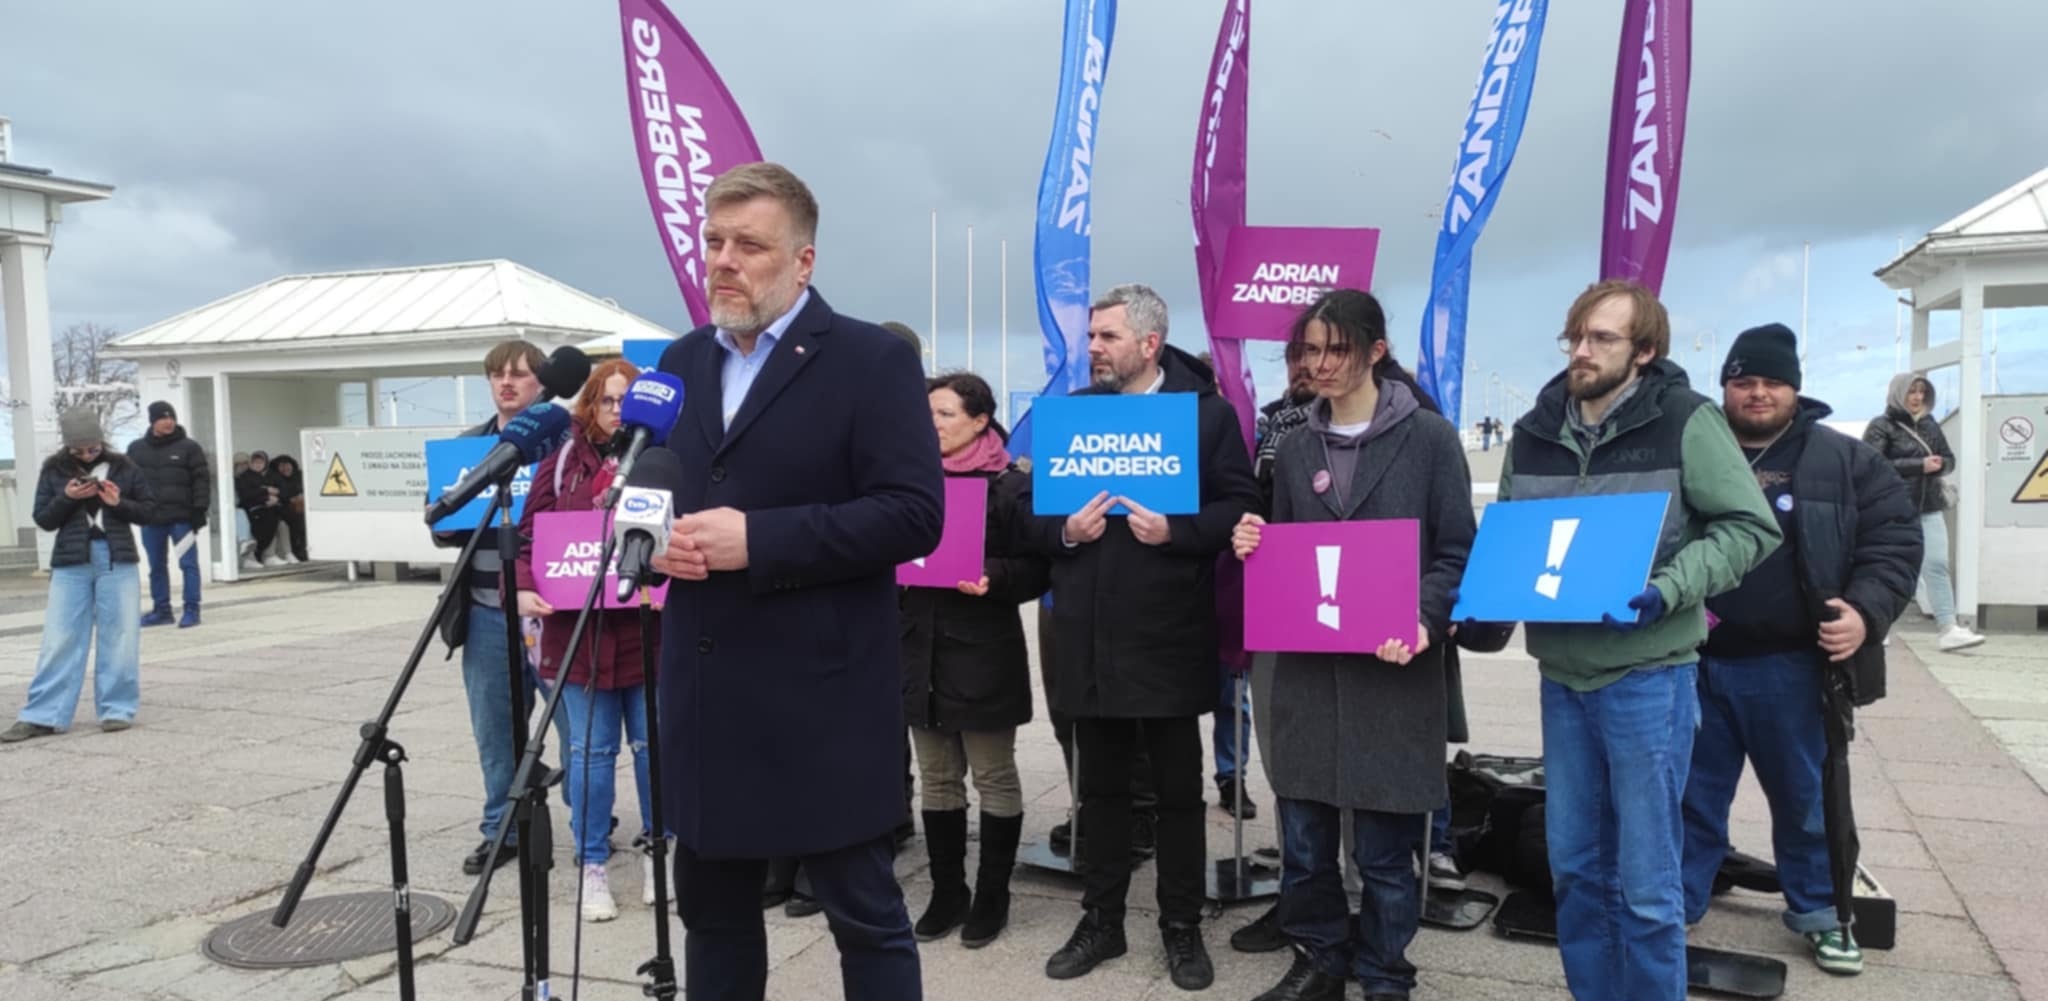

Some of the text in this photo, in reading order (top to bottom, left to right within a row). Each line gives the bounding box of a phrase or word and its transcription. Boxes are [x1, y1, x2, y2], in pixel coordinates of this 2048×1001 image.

[1253, 262, 1340, 284] ADRIAN
[1231, 283, 1333, 305] ZANDBE
[1068, 433, 1162, 454] ADRIAN
[1049, 455, 1182, 477] ZANDBERG
[545, 560, 618, 578] ZANDB
